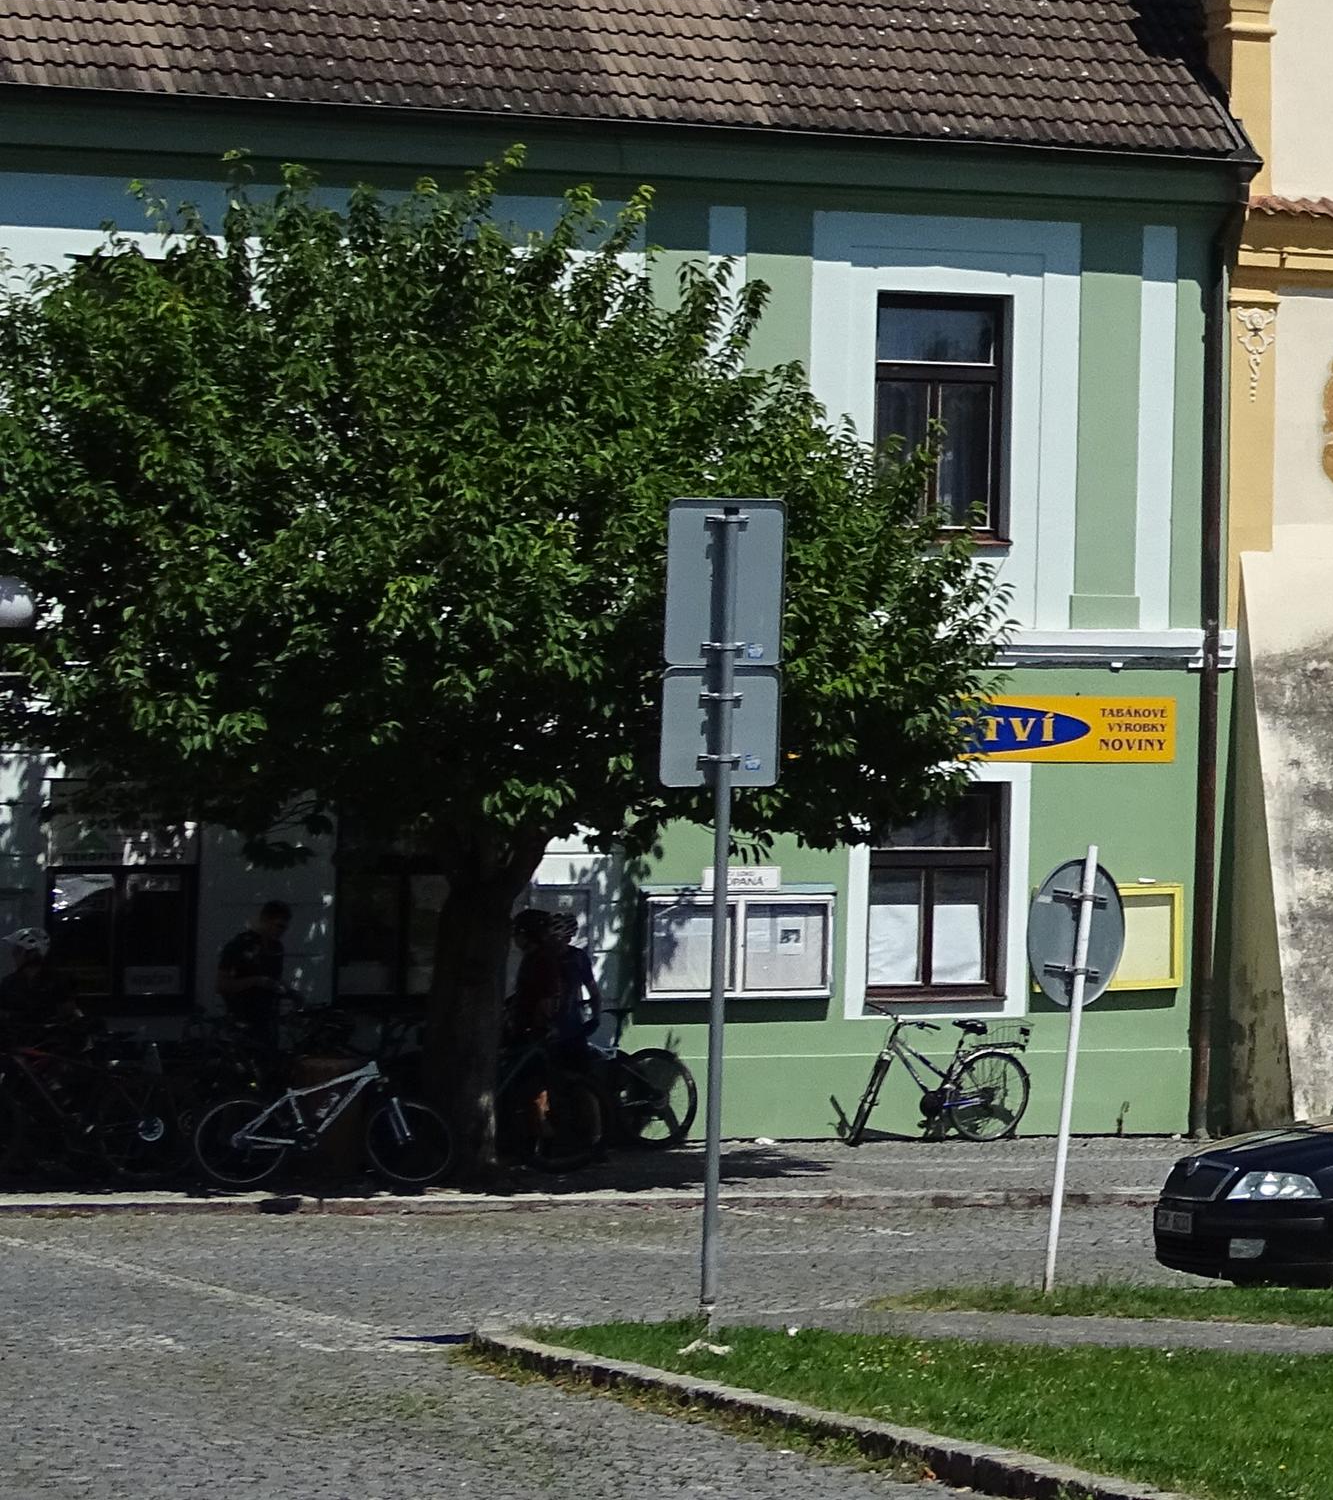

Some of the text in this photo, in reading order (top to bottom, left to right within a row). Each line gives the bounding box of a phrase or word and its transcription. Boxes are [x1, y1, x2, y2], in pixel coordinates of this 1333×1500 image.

[1100, 706, 1168, 718] TABÁKOVÉ
[1107, 720, 1167, 732] VÝROBKY
[1099, 738, 1167, 751] NOVINY
